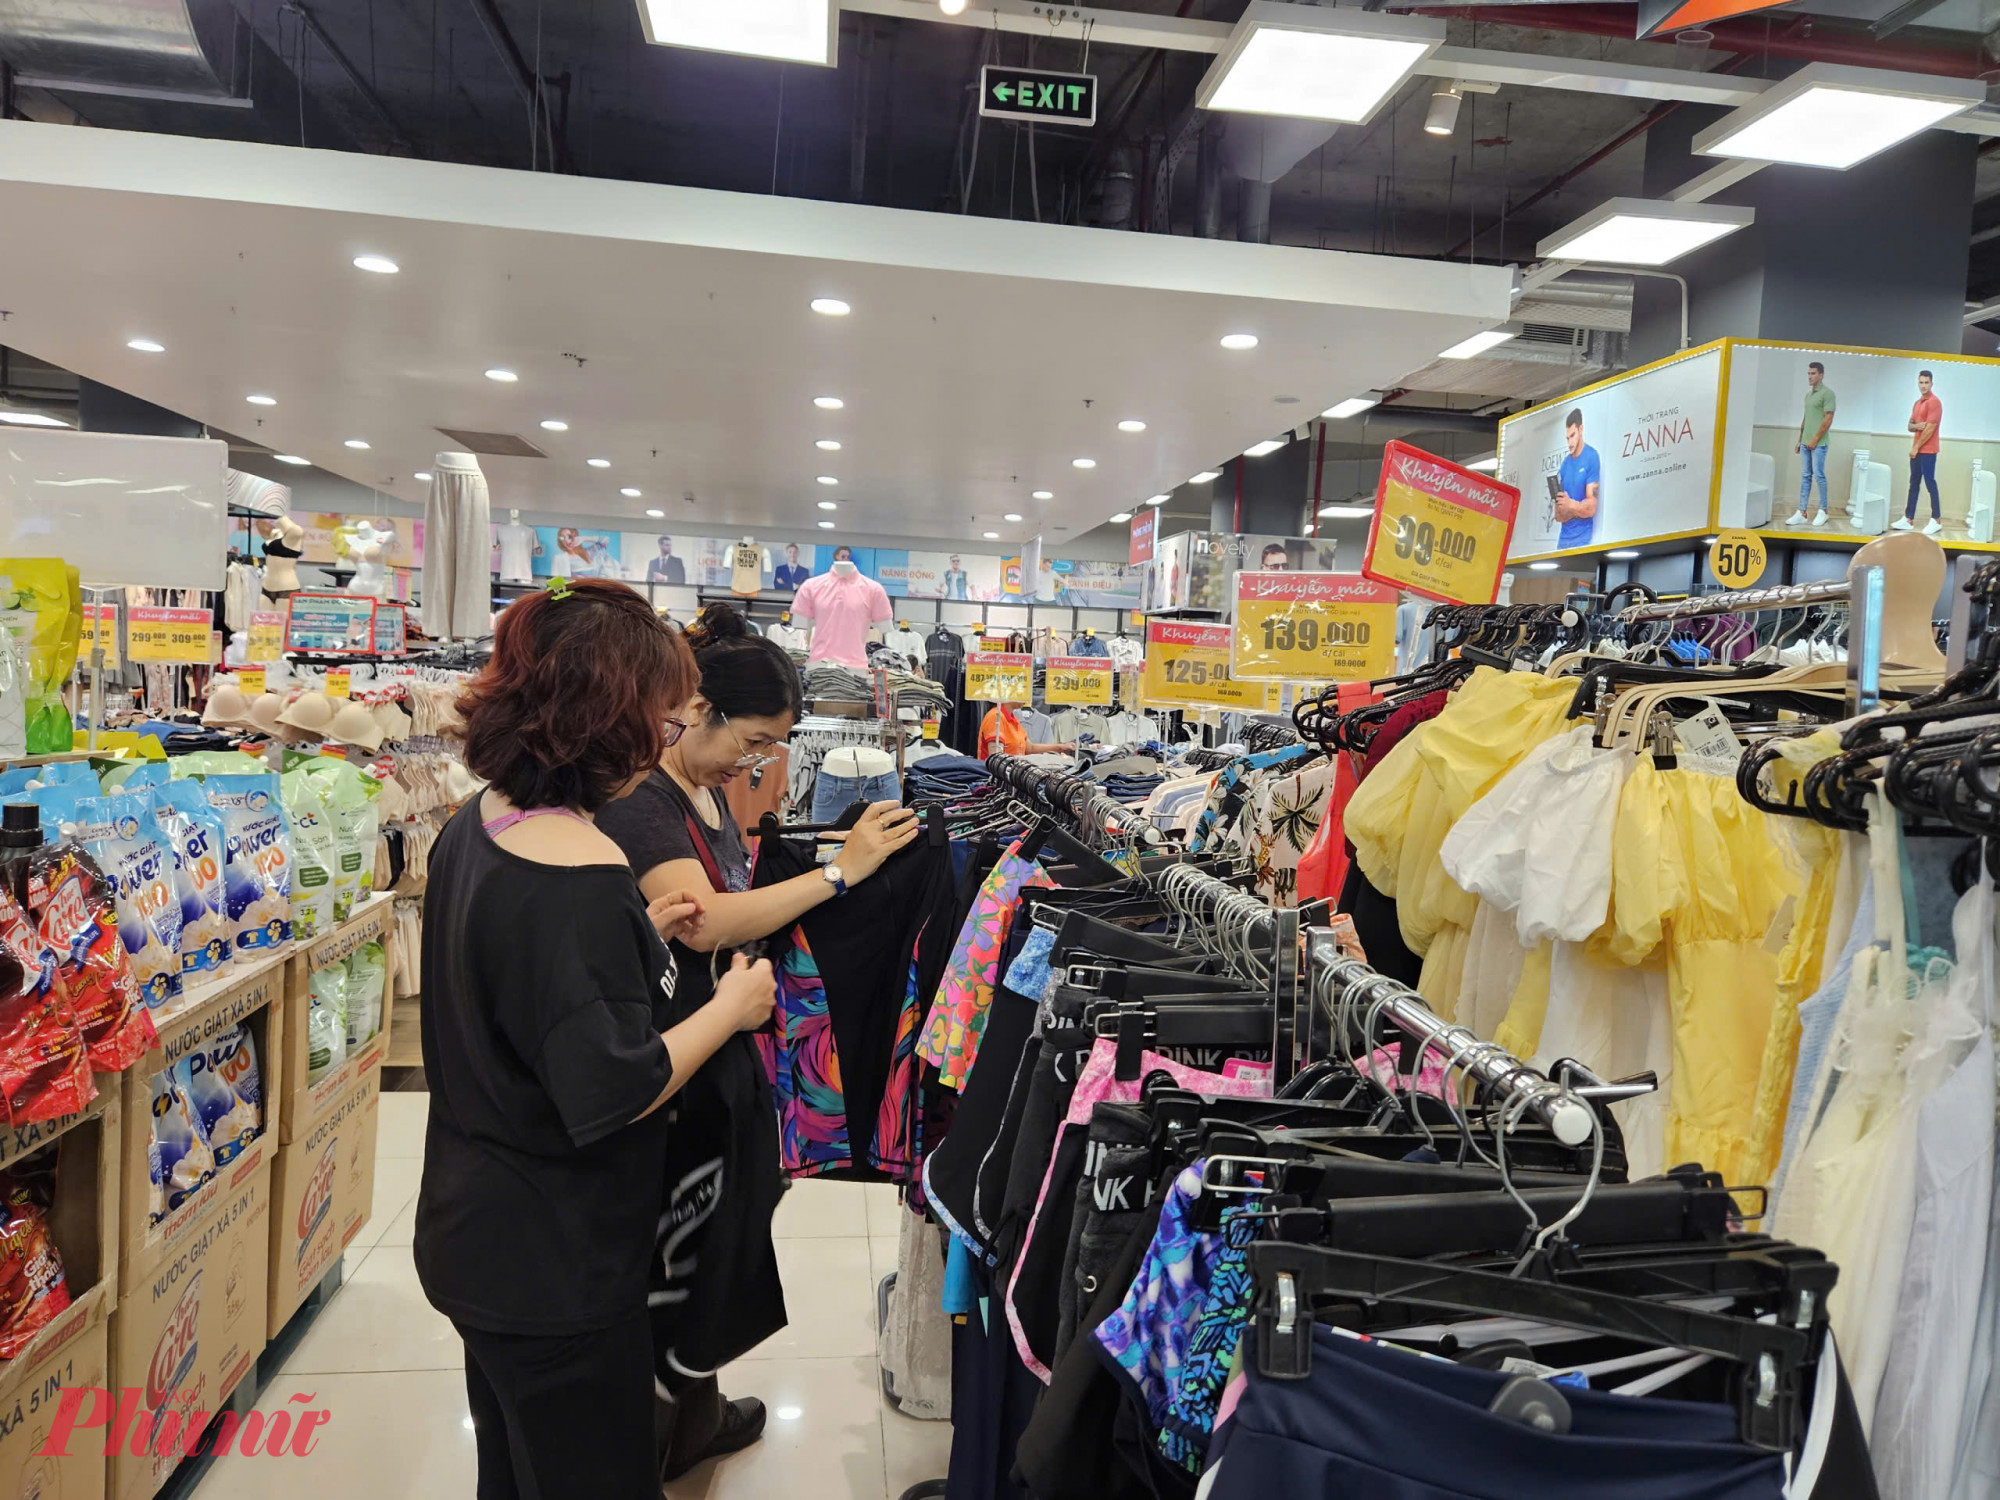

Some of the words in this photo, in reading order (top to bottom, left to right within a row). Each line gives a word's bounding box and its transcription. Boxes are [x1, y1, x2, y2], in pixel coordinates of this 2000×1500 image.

[1018, 80, 1087, 112] EXIT
[1656, 406, 1680, 420] TRANG
[1622, 418, 1695, 458] ZANNA
[1401, 457, 1466, 493] Khuyến
[1467, 487, 1500, 508] mãi
[1625, 463, 1688, 482] www.zanna.online
[1197, 537, 1255, 561] novelty
[1395, 514, 1477, 566] 99.000
[1718, 544, 1761, 577] 50%
[1257, 577, 1333, 598] Khuyến
[1337, 581, 1379, 596] mãi
[1162, 627, 1222, 644] Khuyến
[1260, 618, 1371, 651] 139.000
[165, 1025, 201, 1063] NƯỚC
[203, 1006, 229, 1037] GIẶT
[230, 994, 245, 1022] XẢ
[246, 991, 252, 1011] 5
[253, 984, 263, 1006] IN
[264, 982, 269, 998] 1
[1155, 1046, 1223, 1067] PINK
[305, 1122, 329, 1155] NƯỚC
[152, 1253, 188, 1304] NƯỚC
[190, 1226, 215, 1263] GIẶT
[216, 1207, 230, 1239] XẢ
[231, 1203, 238, 1222] 5
[239, 1192, 249, 1215] IN
[30, 1387, 40, 1414] 5
[44, 1368, 61, 1403] IN
[65, 1358, 73, 1382] 1
